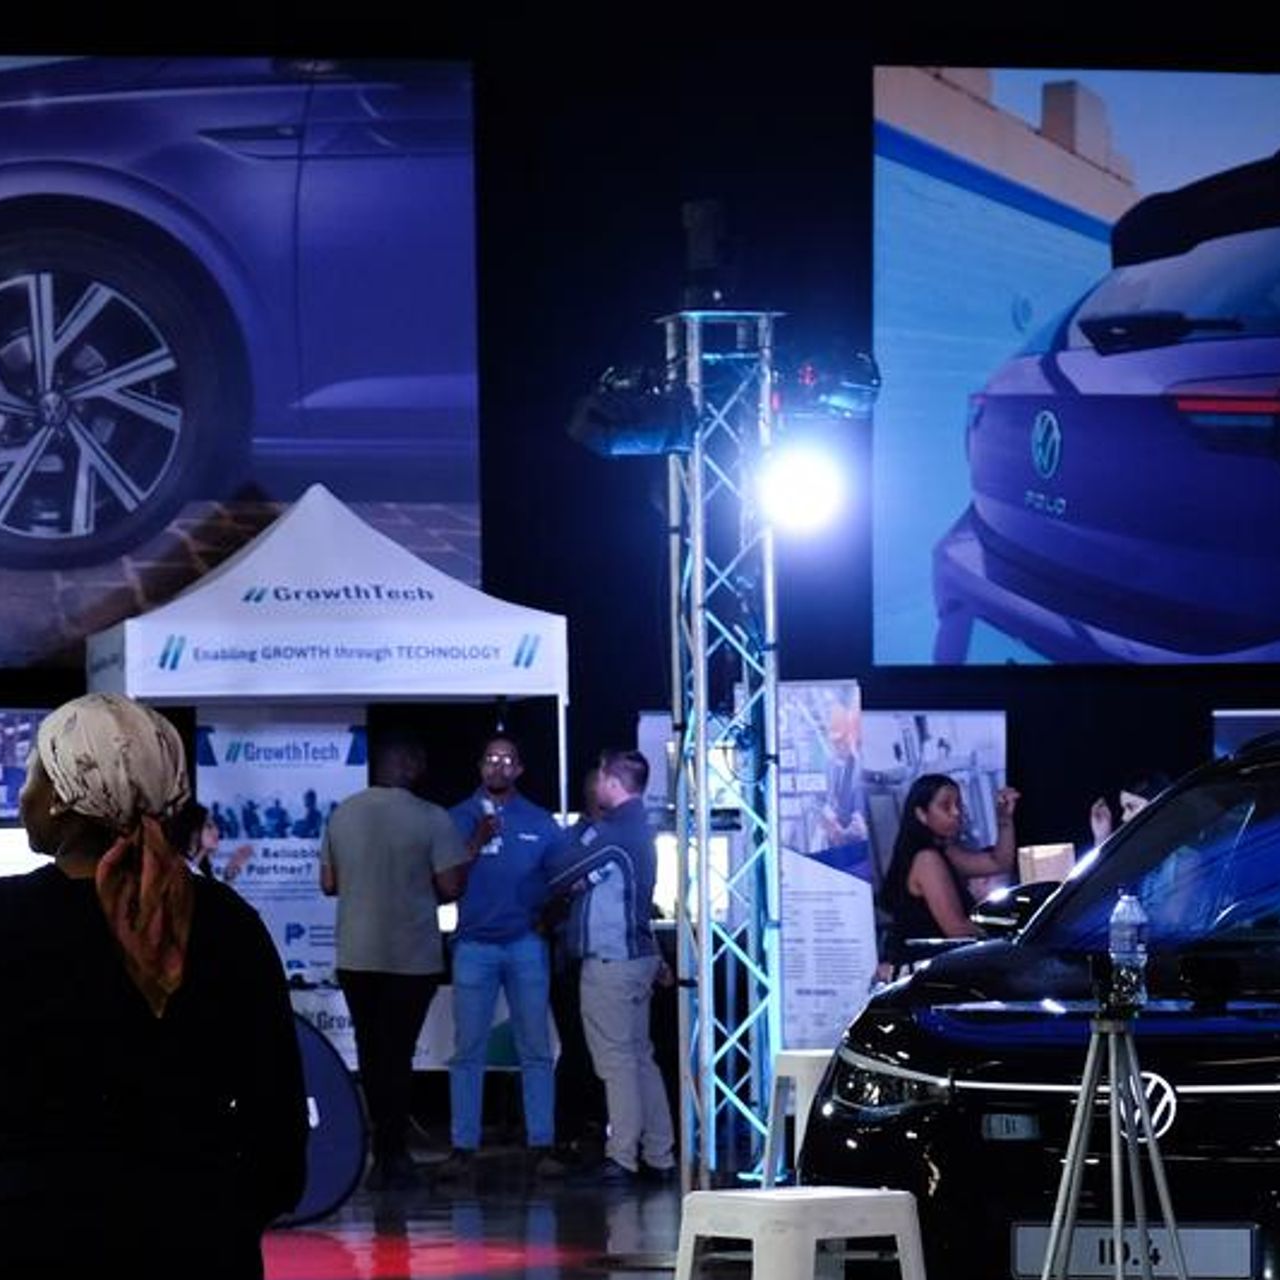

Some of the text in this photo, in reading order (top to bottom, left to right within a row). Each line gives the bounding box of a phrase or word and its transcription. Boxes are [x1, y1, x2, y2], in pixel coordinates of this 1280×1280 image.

[273, 585, 434, 602] GrowthTech
[193, 645, 501, 663] Enabling GROWTH through TECHNOLOGY
[243, 741, 340, 762] GrowthTech
